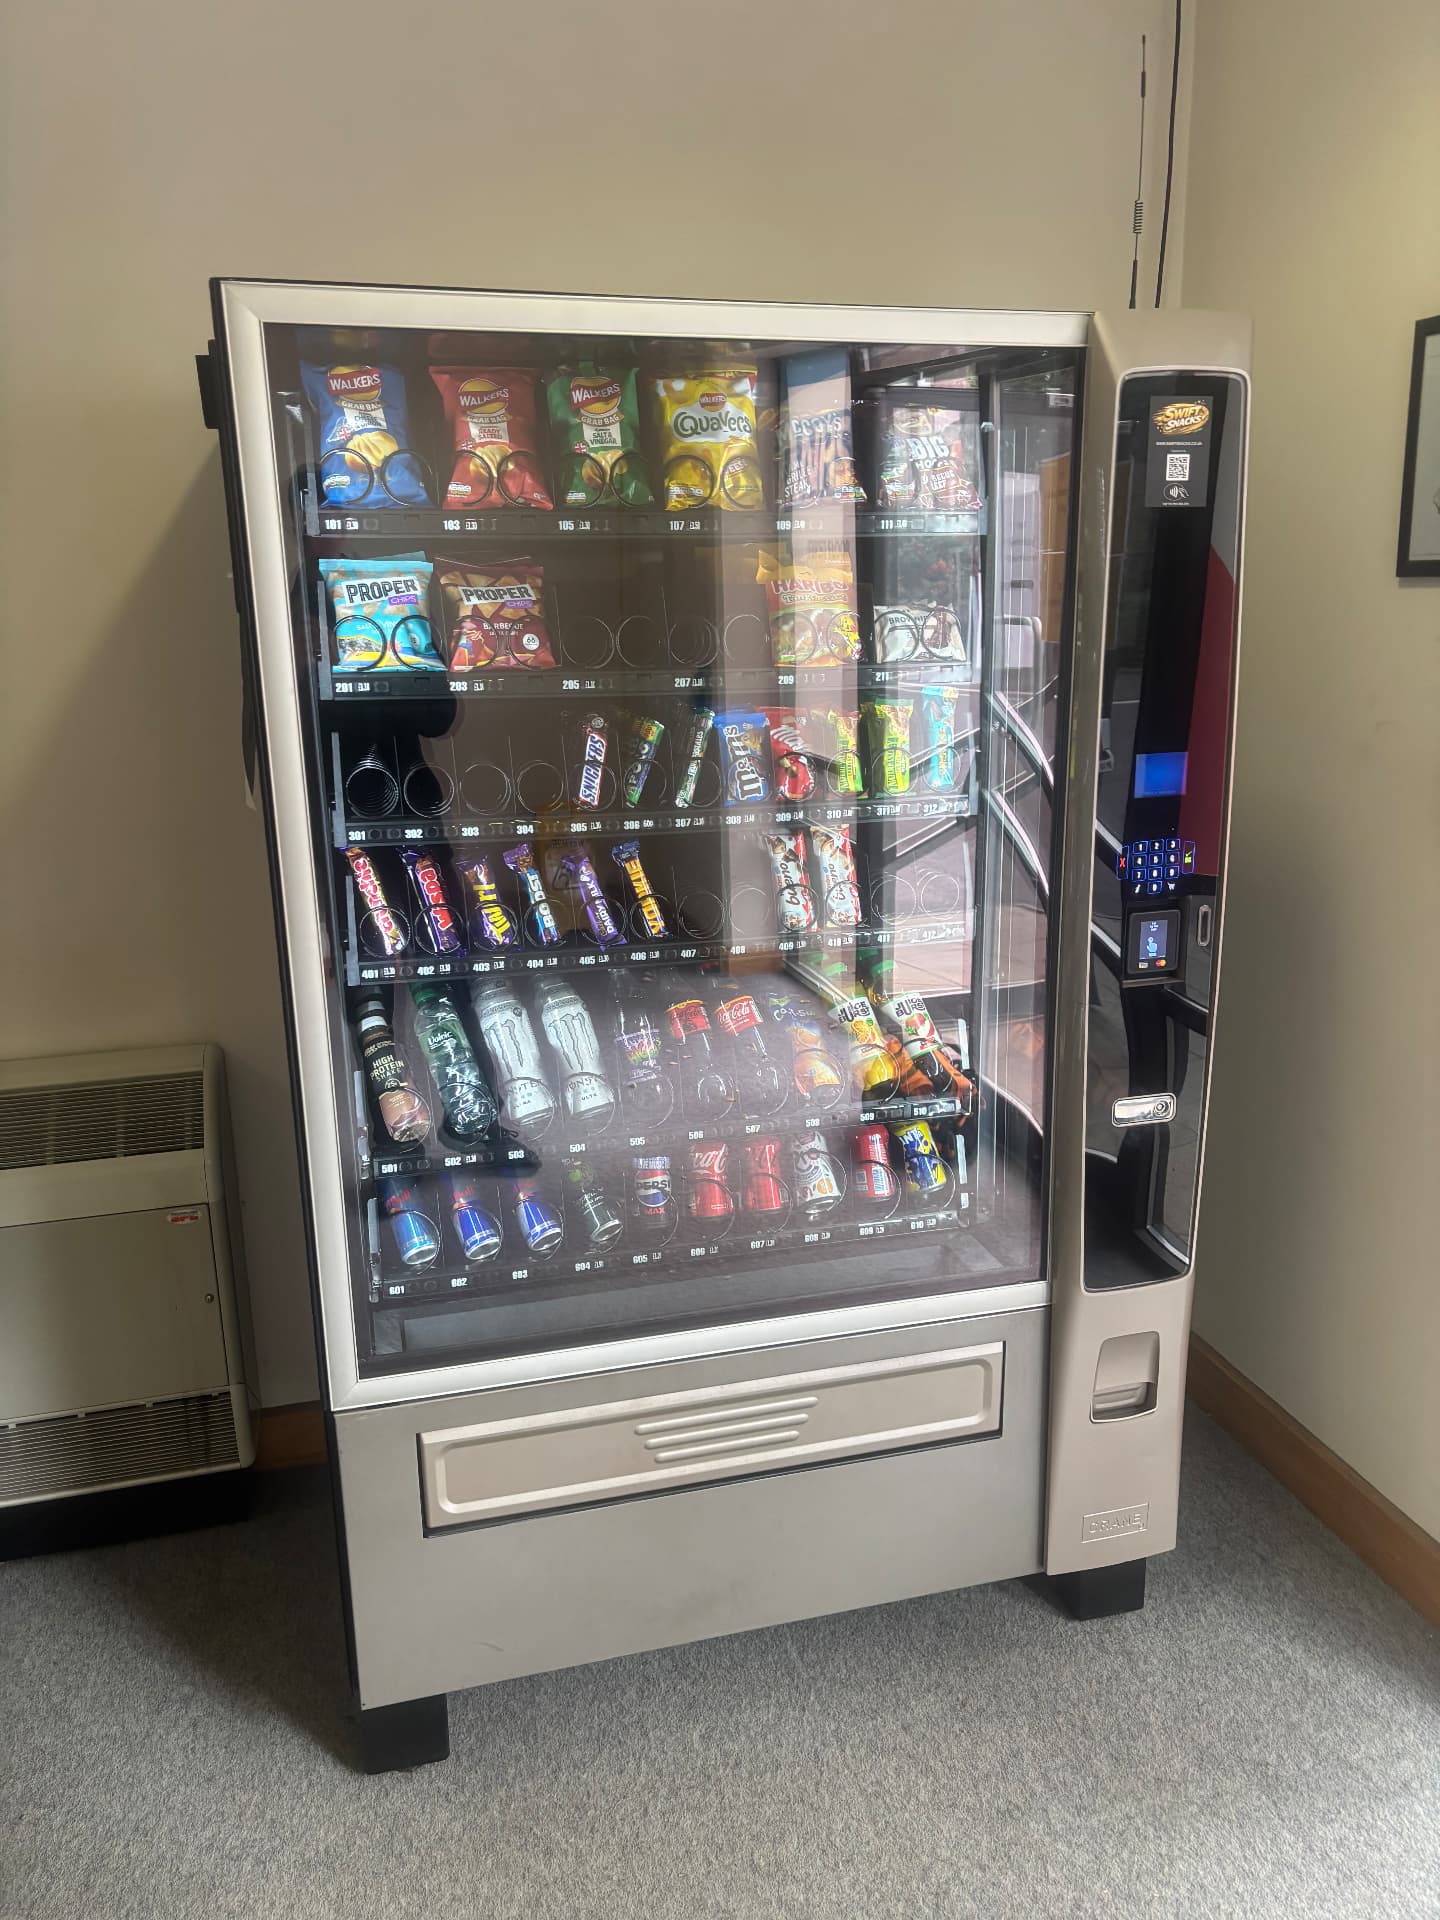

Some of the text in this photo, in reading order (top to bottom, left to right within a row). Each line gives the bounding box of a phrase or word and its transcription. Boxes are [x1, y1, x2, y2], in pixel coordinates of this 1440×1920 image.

[330, 374, 380, 390] WALKERS
[460, 388, 509, 406] WALKERS
[572, 383, 620, 404] WALKERS
[1164, 405, 1201, 420] SWIFT
[581, 413, 619, 426] GRAB BAG
[1165, 415, 1203, 430] SNACKS
[907, 435, 949, 460] BIG
[324, 519, 342, 530] 101
[443, 519, 460, 530] 103
[558, 520, 575, 531] 105
[669, 520, 685, 531] 107
[776, 520, 791, 531] 109
[880, 519, 894, 530] 111
[346, 579, 418, 604] PROPER
[770, 577, 850, 595] HARIBO
[461, 586, 533, 602] PROPER
[390, 595, 417, 605] CHIPS
[778, 675, 794, 685] 209
[875, 671, 890, 682] 211
[335, 682, 353, 693] 201
[449, 681, 468, 692] 203
[562, 679, 579, 690] 205
[674, 678, 691, 688] 207
[580, 733, 605, 804] SNICKERS
[826, 809, 842, 819] 310
[876, 806, 890, 816] 311
[725, 815, 742, 825] 308
[775, 812, 792, 822] 309
[570, 822, 588, 832] 305
[623, 820, 640, 830] 306
[675, 818, 690, 828] 307
[404, 828, 423, 839] 302
[461, 827, 480, 837] 303
[516, 824, 534, 835] 304
[348, 830, 366, 841] 301
[779, 862, 800, 906] bueno
[526, 872, 557, 928] BOOST
[624, 860, 666, 936] YORKIE
[597, 902, 615, 934] DAIRY
[827, 937, 842, 948] 410
[877, 933, 891, 943] 411
[778, 941, 794, 951] 409
[630, 952, 647, 961] 406
[680, 949, 697, 959] 407
[526, 959, 544, 969] 404
[578, 956, 596, 965] 405
[416, 966, 435, 976] 402
[472, 962, 490, 972] 403
[361, 969, 379, 979] 401
[372, 1055, 394, 1069] HIGH
[369, 1060, 404, 1081] PROTEIN
[377, 1068, 402, 1082] SHAKE
[913, 1106, 928, 1116] 510
[860, 1112, 875, 1122] 509
[745, 1124, 761, 1134] 507
[688, 1130, 704, 1140] 506
[629, 1136, 645, 1146] 505
[569, 1143, 586, 1153] 504
[508, 1150, 525, 1160] 503
[444, 1156, 462, 1167] 502
[381, 1163, 398, 1174] 501
[637, 1180, 671, 1191] PEPSI
[645, 1206, 666, 1215] MAX
[910, 1219, 924, 1230] 610
[859, 1225, 874, 1236] 609
[750, 1239, 765, 1250] 607
[690, 1246, 706, 1257] 606
[632, 1254, 648, 1264] 605
[575, 1261, 591, 1272] 604
[512, 1270, 528, 1280] 603
[451, 1277, 468, 1288] 602
[389, 1284, 405, 1295] 601
